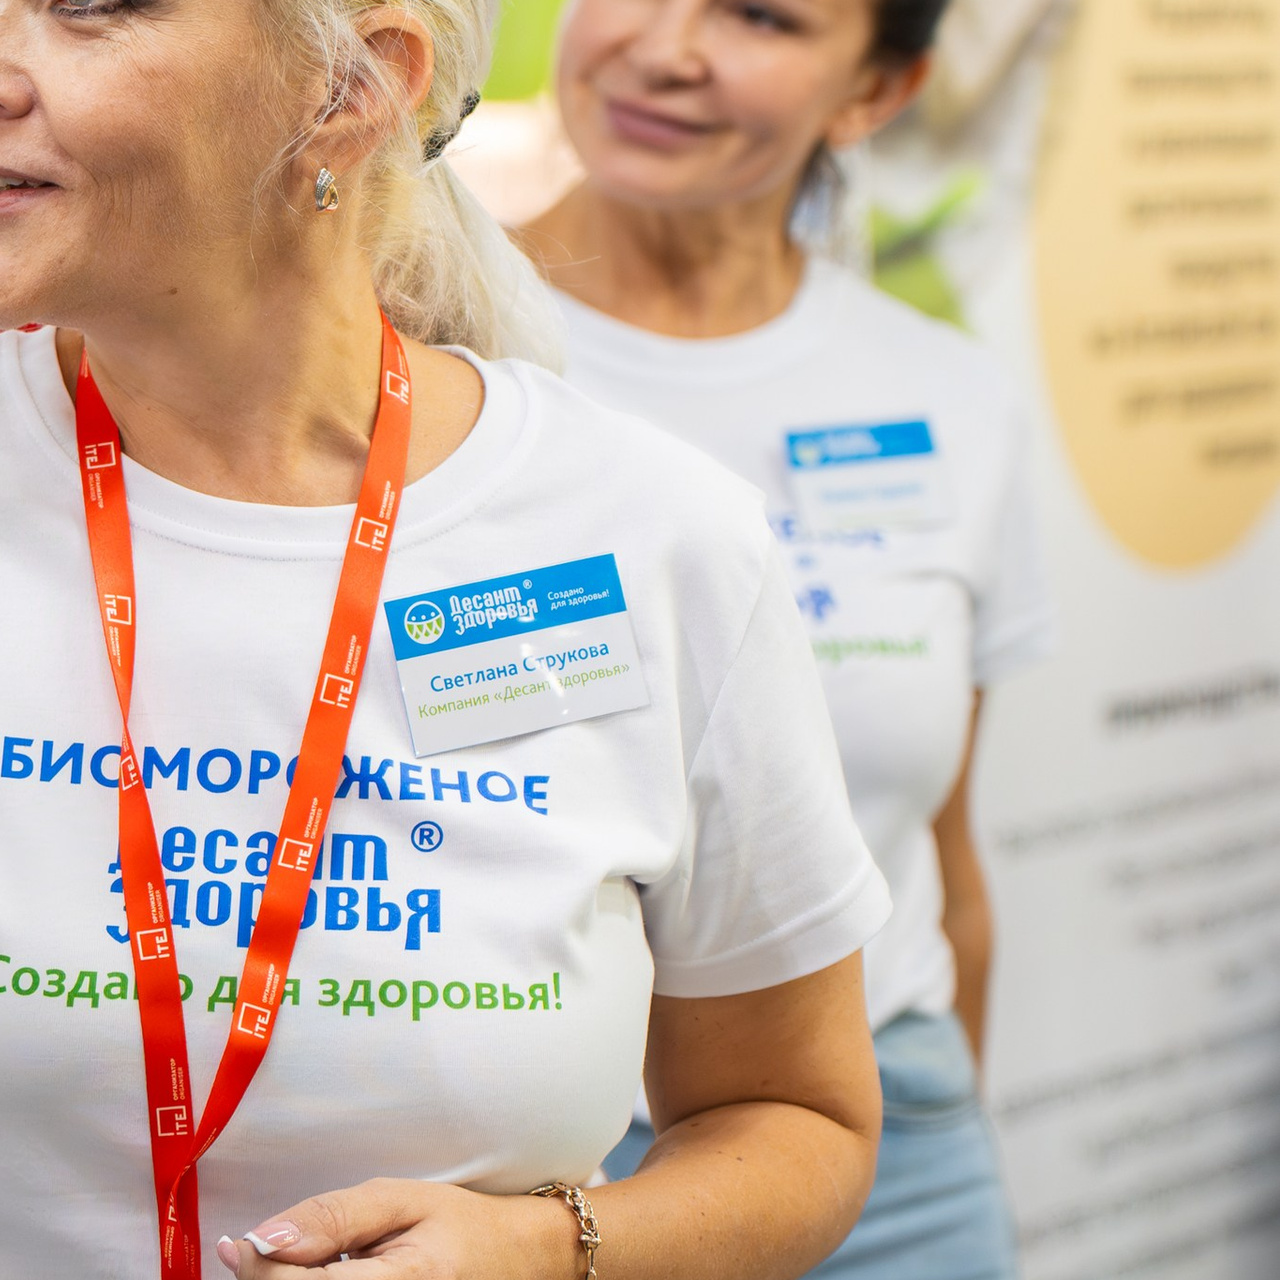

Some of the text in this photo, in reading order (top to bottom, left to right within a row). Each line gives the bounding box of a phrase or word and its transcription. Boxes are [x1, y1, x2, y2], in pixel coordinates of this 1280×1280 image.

[449, 585, 522, 617] Десант
[547, 586, 585, 601] Создано
[550, 589, 610, 611] для здоровья!
[418, 663, 630, 719] Компания «Десант здоровья»
[430, 641, 610, 693] Светлана Струкова
[0, 735, 550, 816] БИОМОРЖЕНОЕ
[108, 825, 389, 882] есат
[206, 974, 300, 1013] дя
[318, 973, 562, 1021] здоровья!
